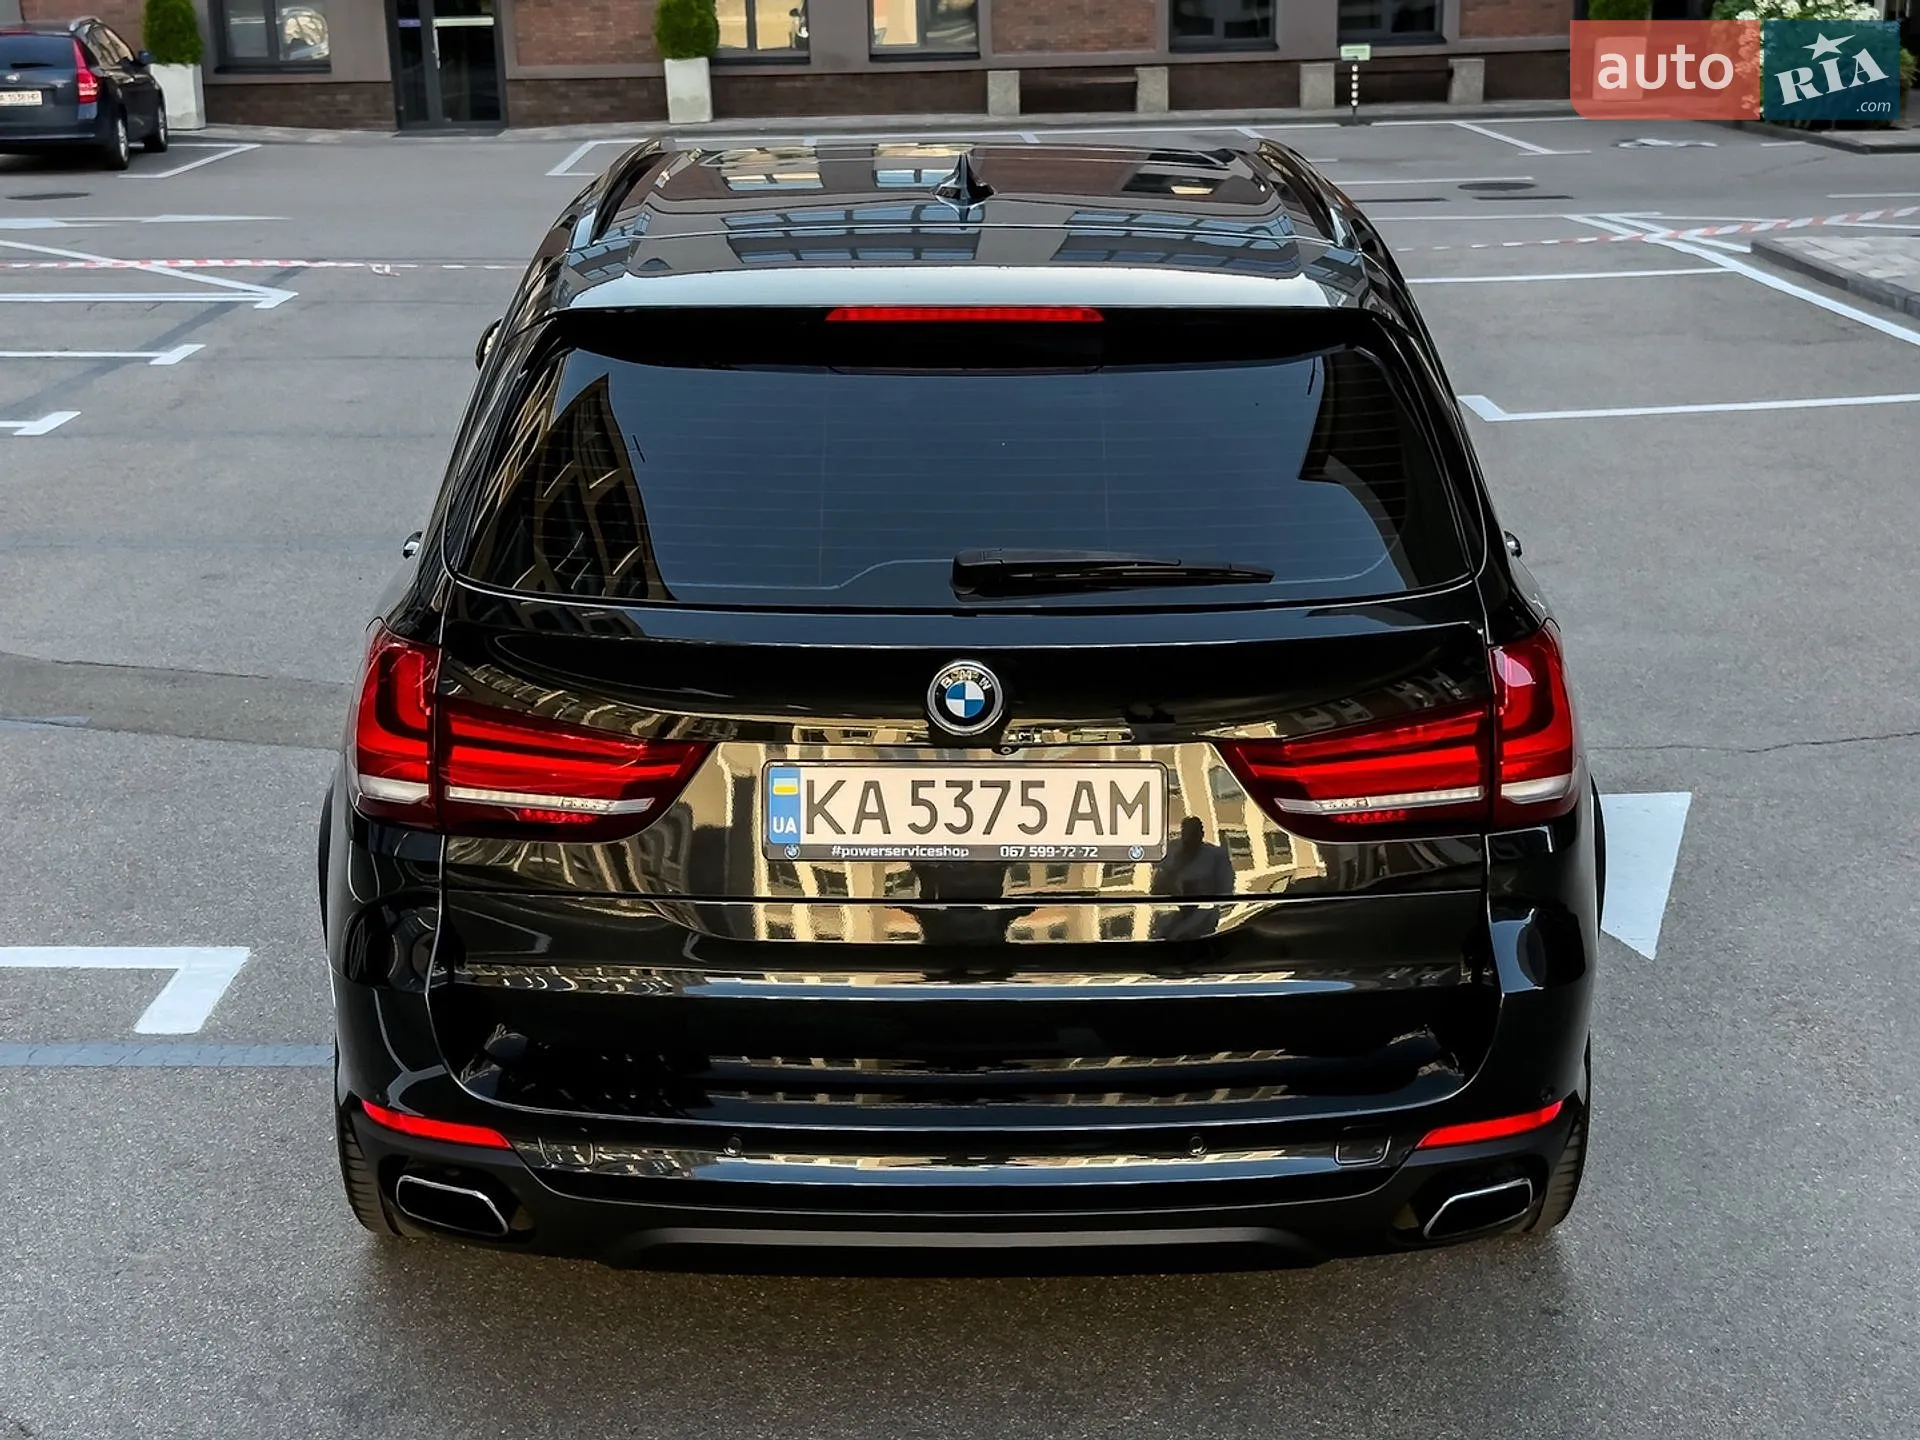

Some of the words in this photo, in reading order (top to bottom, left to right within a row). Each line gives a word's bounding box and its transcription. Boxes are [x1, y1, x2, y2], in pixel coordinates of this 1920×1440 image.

[940, 669, 992, 691] BMW
[806, 779, 891, 836] KA
[907, 780, 1049, 836] 5375
[1066, 780, 1150, 836] AM
[773, 816, 797, 834] UA
[831, 845, 970, 859] #powerserviceshop
[1000, 846, 1026, 858] 067
